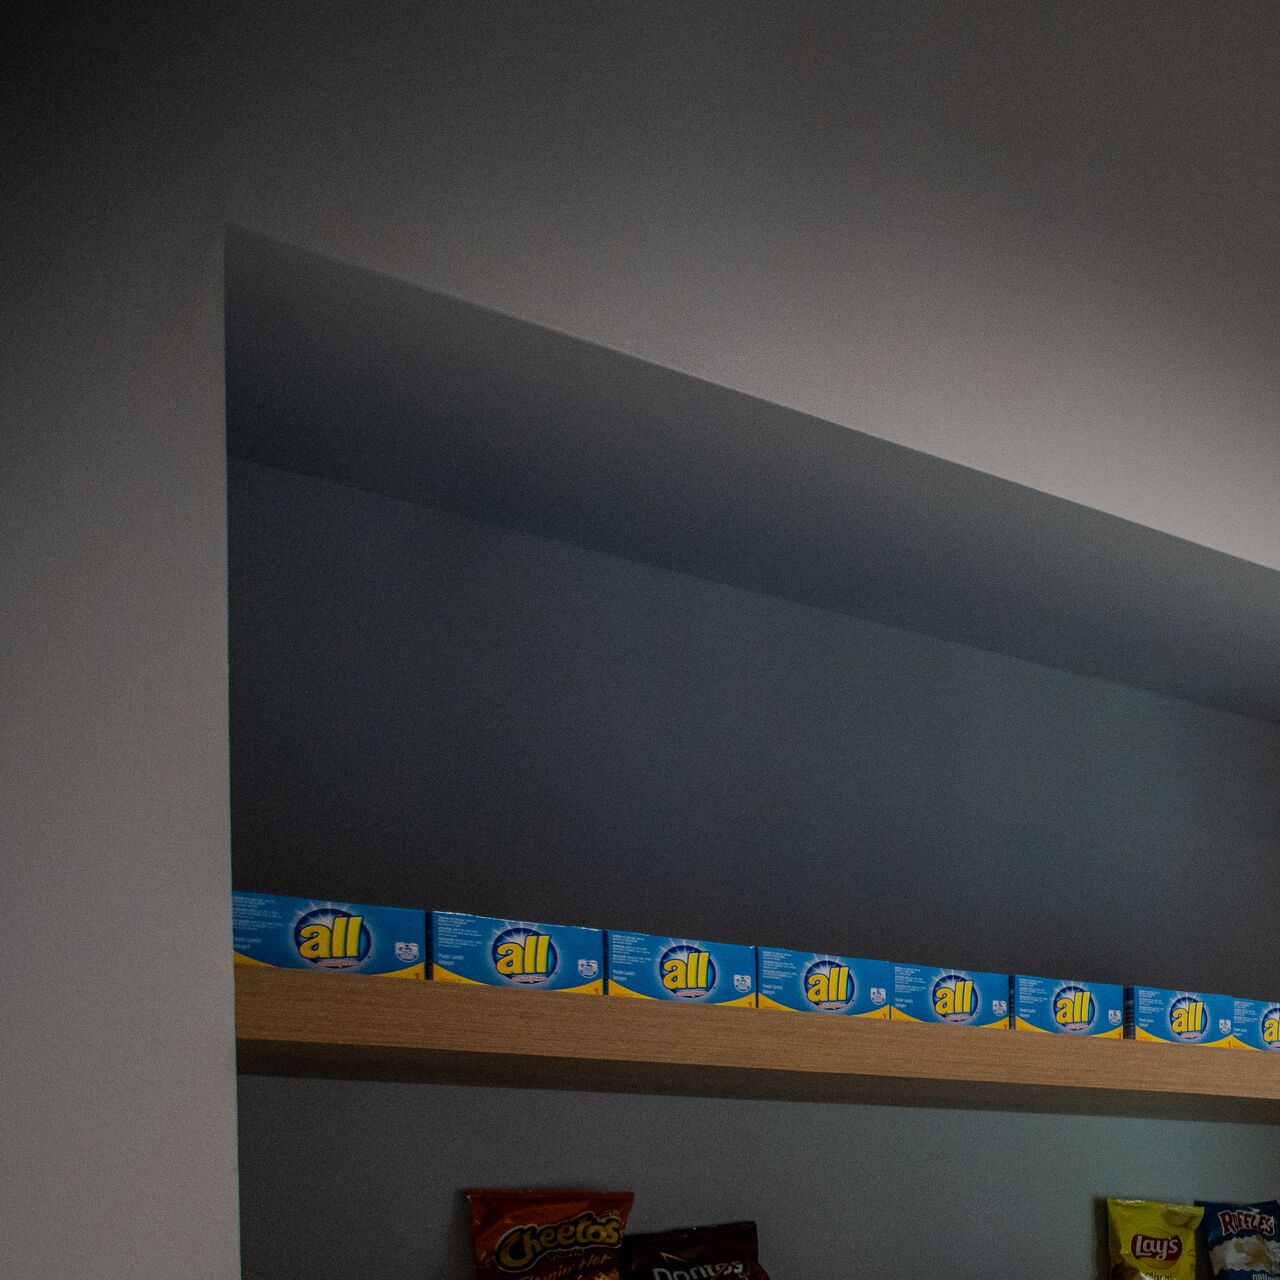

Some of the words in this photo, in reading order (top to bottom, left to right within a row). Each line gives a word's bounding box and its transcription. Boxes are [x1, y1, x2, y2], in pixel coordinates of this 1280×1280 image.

[299, 915, 363, 959] all
[496, 934, 550, 975] all
[663, 951, 709, 989] all
[807, 966, 849, 1002] all
[935, 980, 974, 1015] all
[1055, 991, 1091, 1024] all
[1171, 1001, 1204, 1033] all
[1218, 1209, 1275, 1238] RUFFLES
[497, 1212, 621, 1271] Cheetos
[1131, 1233, 1182, 1262] Lay's
[575, 1253, 614, 1274] Hot
